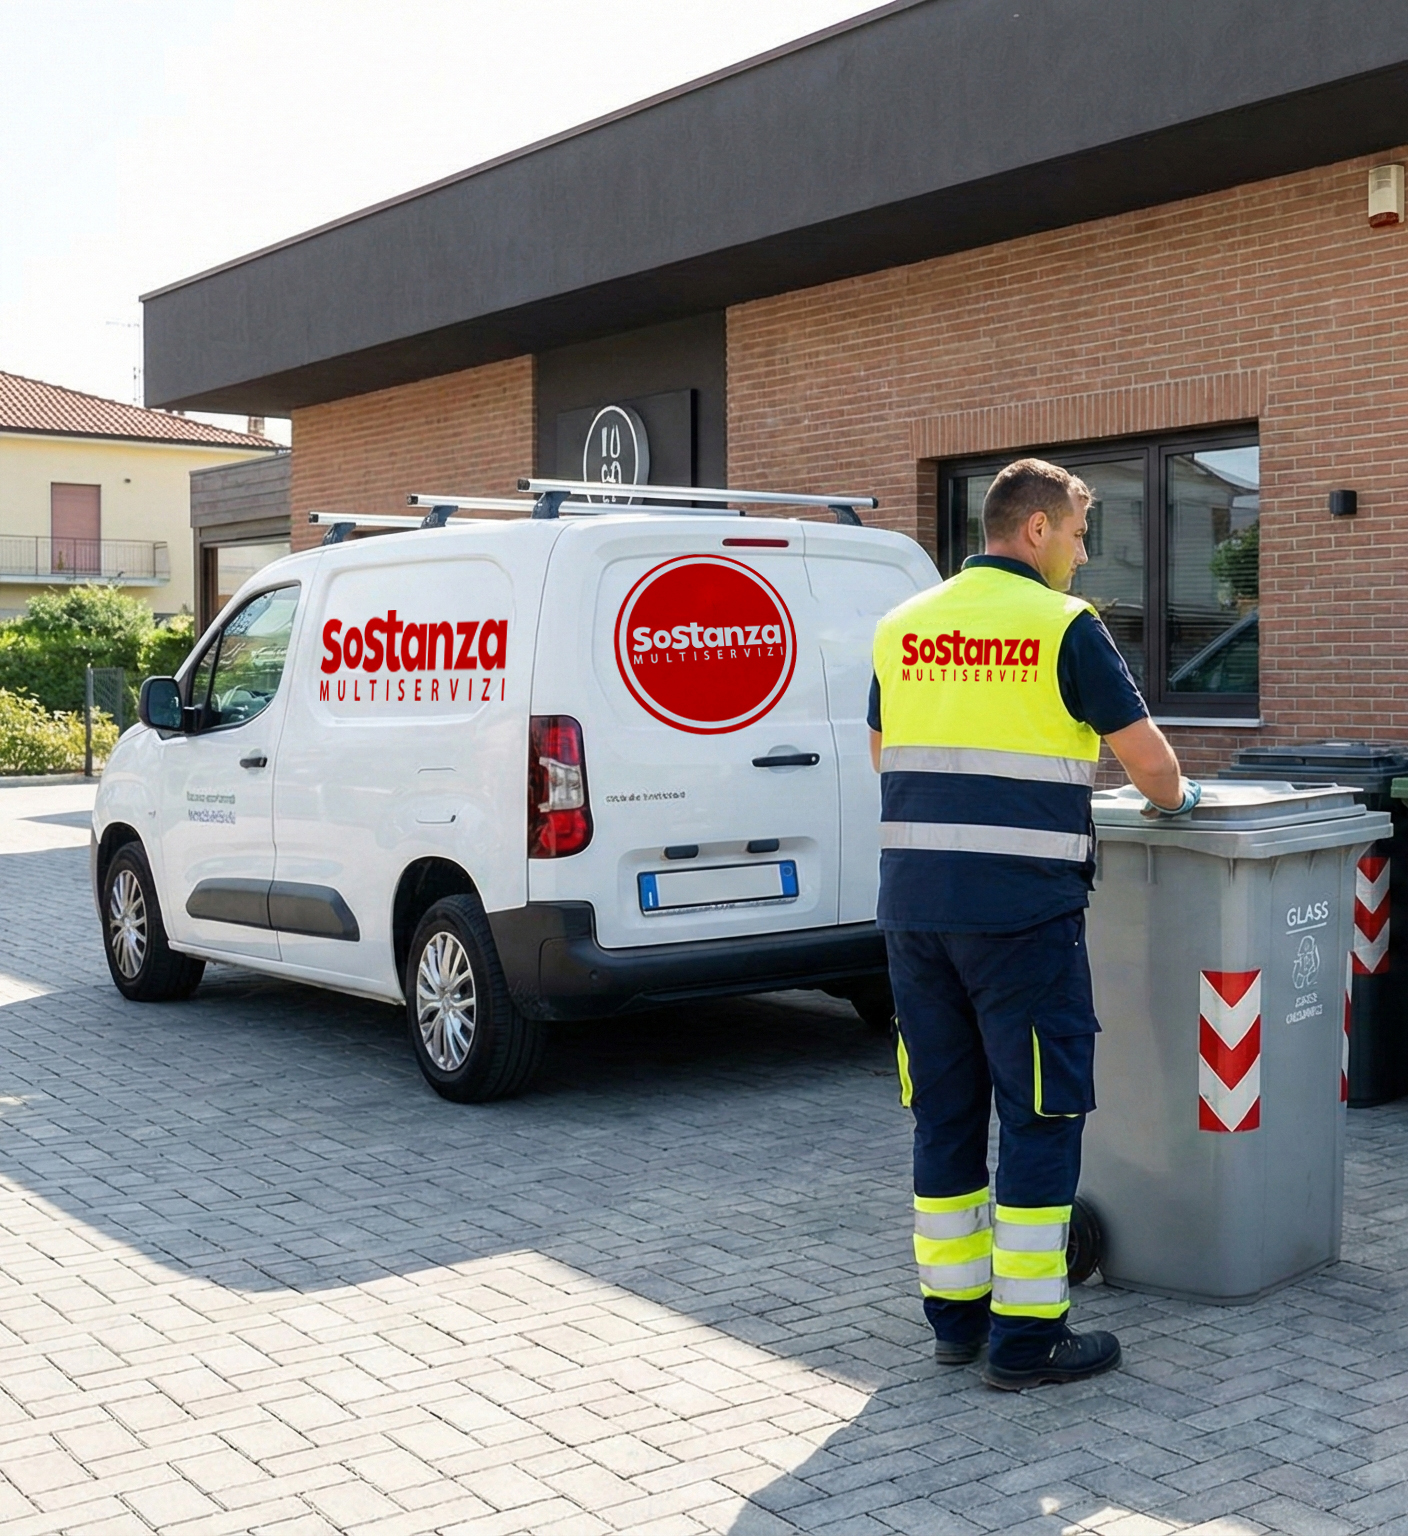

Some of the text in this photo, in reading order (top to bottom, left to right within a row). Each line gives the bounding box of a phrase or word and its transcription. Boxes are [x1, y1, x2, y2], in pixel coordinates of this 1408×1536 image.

[633, 646, 784, 665] MULTISERVIZI
[902, 668, 1038, 683] MULTISERVIZI
[319, 677, 506, 702] MULTISERVIZI
[1286, 900, 1329, 927] GLASS
